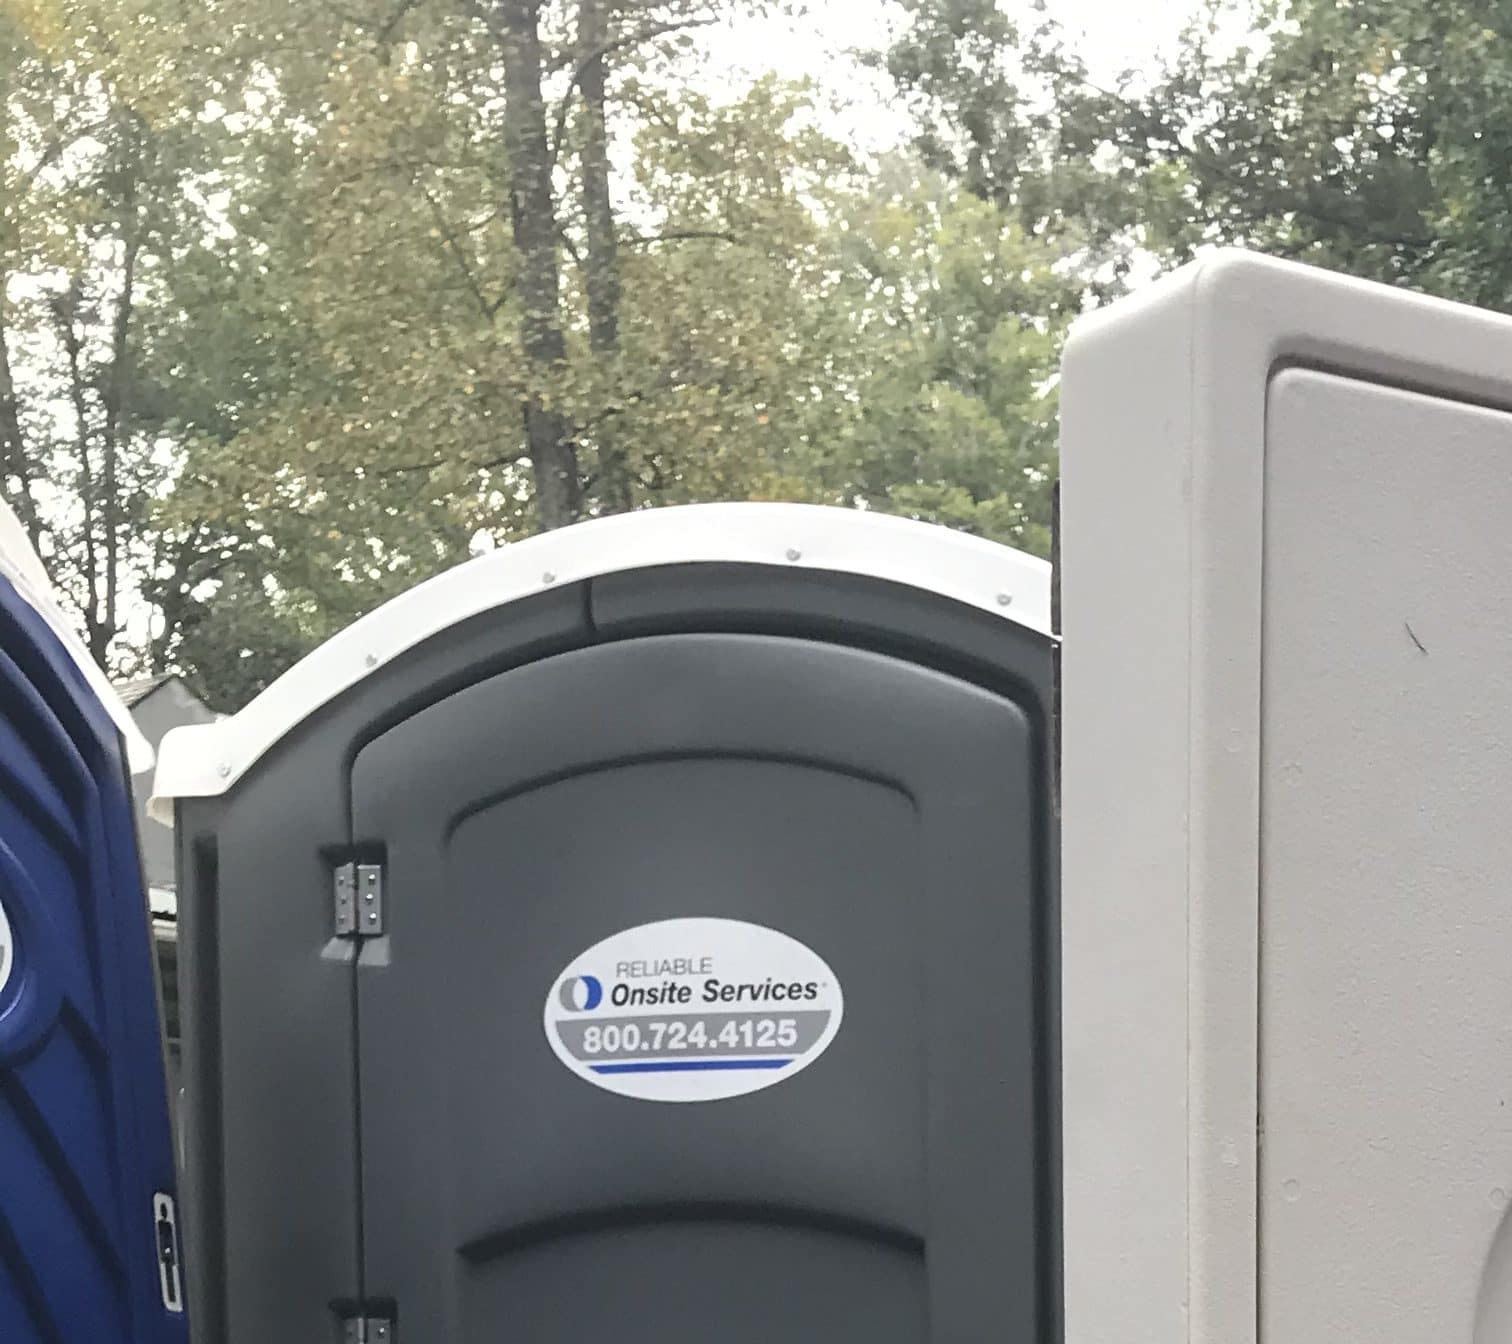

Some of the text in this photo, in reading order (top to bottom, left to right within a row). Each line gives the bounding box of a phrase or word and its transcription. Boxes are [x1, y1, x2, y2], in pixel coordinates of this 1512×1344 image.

[616, 957, 713, 979] RELIABLE
[611, 977, 818, 1006] Onsite Services
[582, 1018, 799, 1053] 800.724.4125
